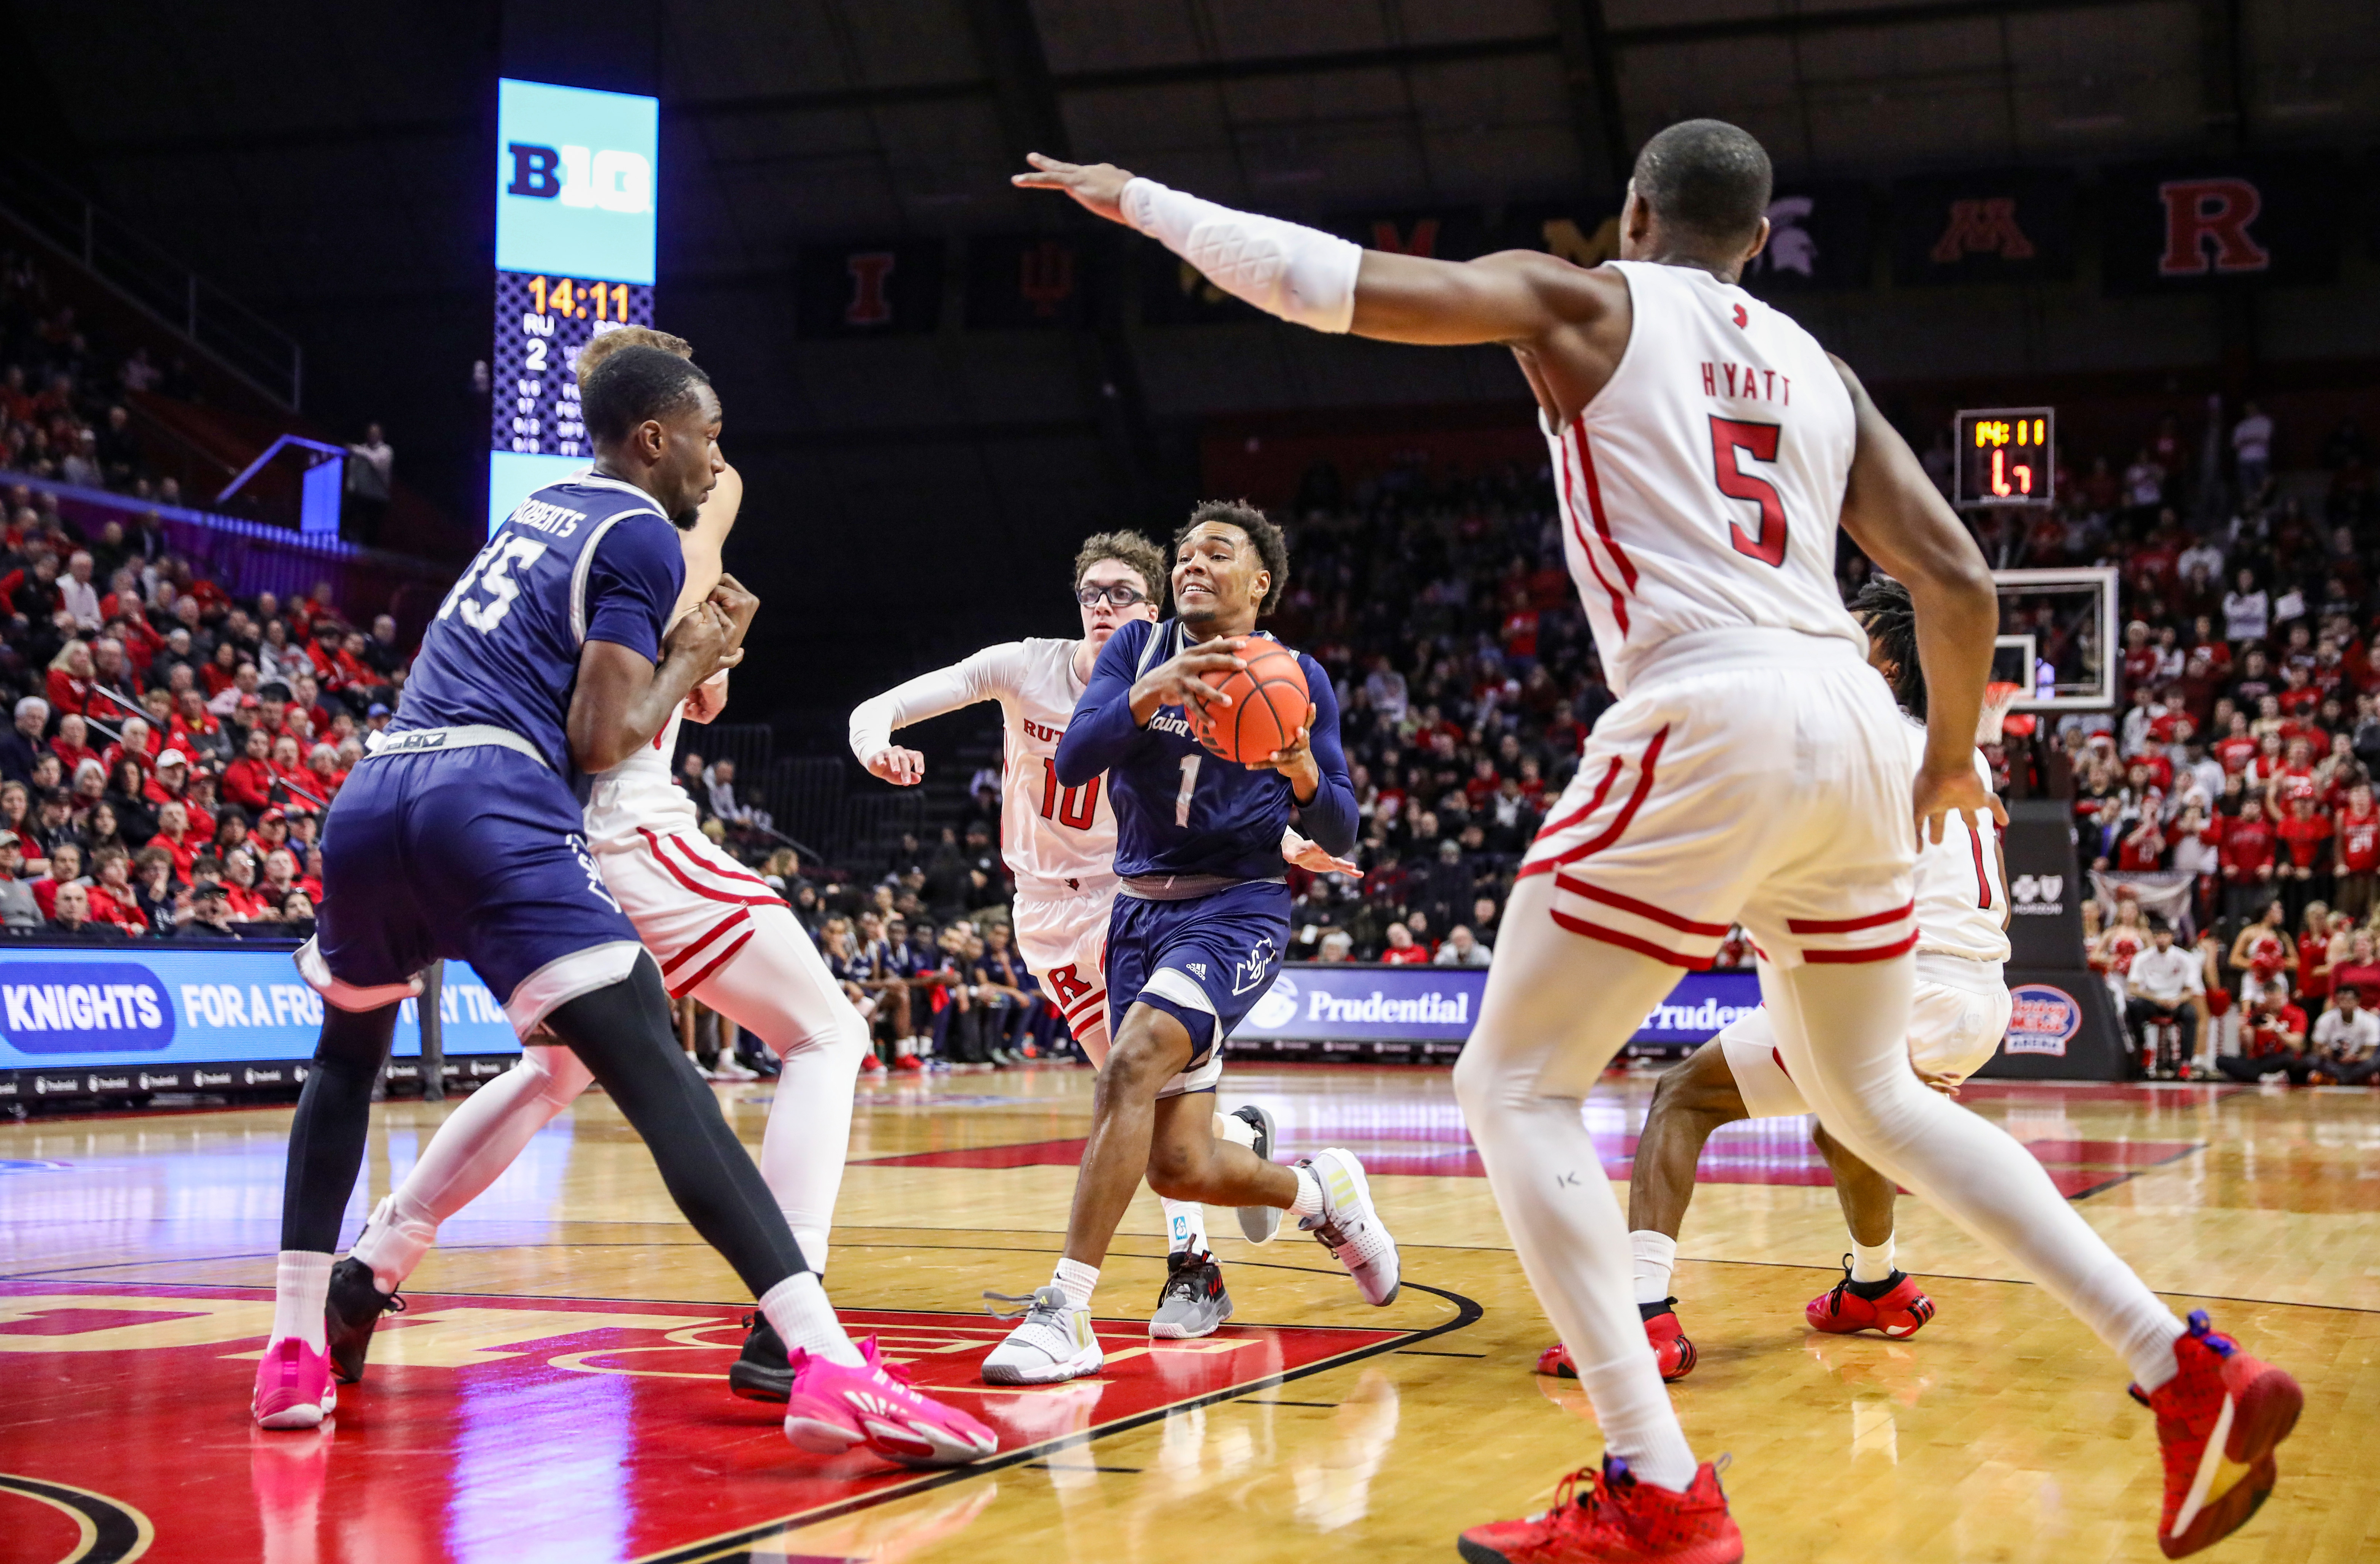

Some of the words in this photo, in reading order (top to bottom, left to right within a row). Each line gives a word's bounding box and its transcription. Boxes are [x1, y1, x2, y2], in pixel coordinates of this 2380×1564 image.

[529, 276, 628, 323] 14:11
[523, 313, 554, 337] RU
[526, 338, 547, 371] 2
[1701, 361, 1791, 406] HYATT
[1708, 413, 1788, 569] 5
[508, 497, 587, 537] ROBERTS
[437, 531, 548, 635] 15
[1040, 757, 1101, 830] 10
[1175, 754, 1202, 828] 1
[1048, 963, 1093, 1009] R
[1186, 963, 1206, 981] adidas
[2, 984, 163, 1031] KNIGHTS
[181, 984, 250, 1028] FOR
[250, 984, 274, 1026] A
[1307, 990, 1469, 1024] Prudential
